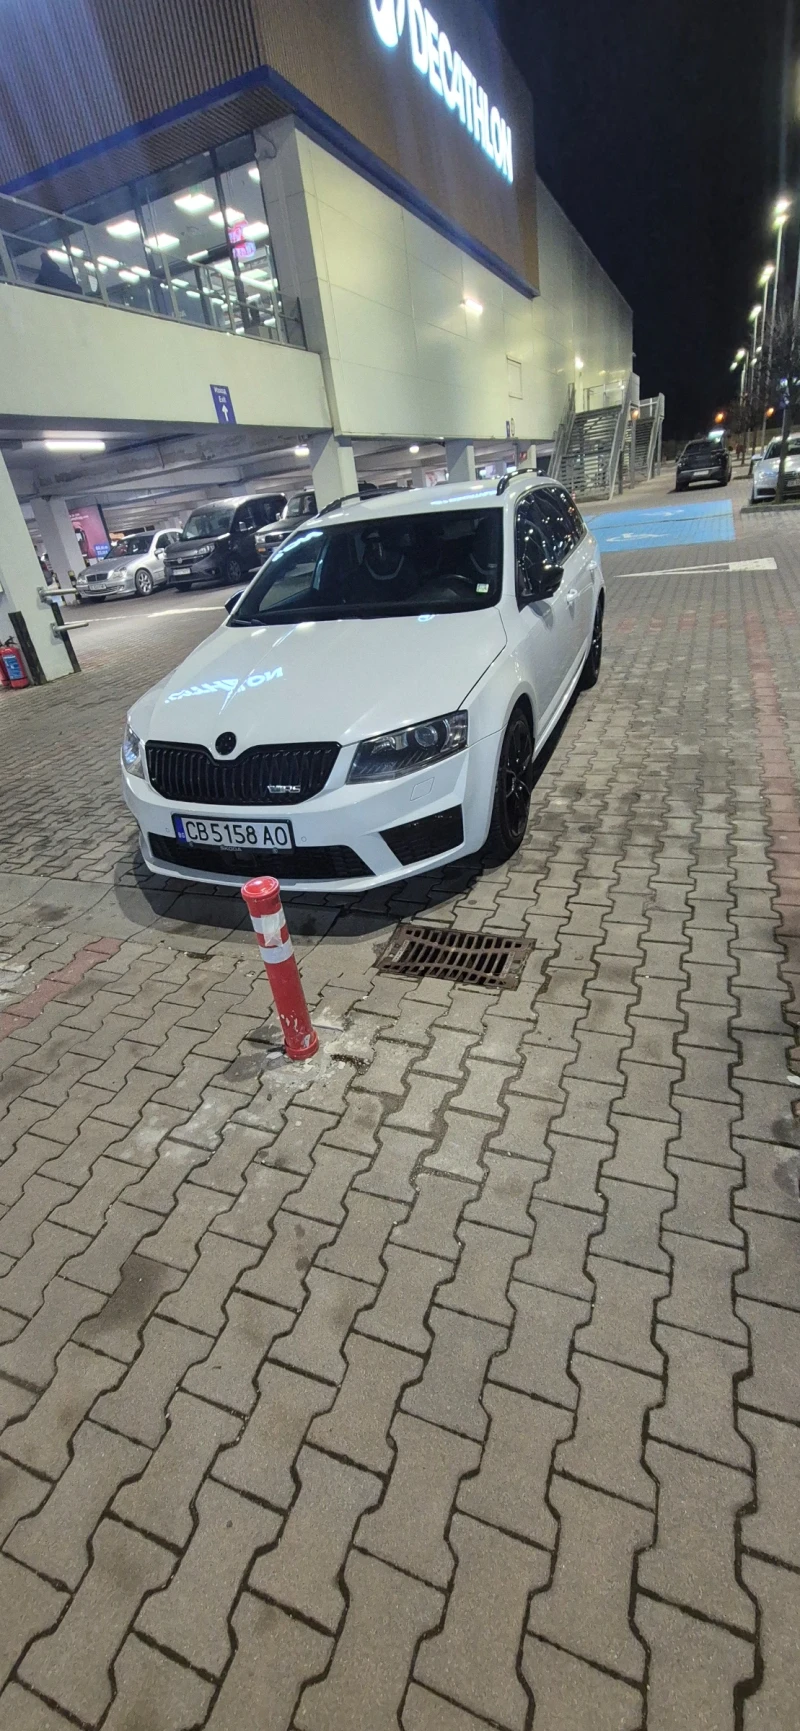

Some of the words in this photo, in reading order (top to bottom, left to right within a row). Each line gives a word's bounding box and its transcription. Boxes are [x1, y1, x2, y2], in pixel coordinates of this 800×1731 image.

[407, 0, 513, 183] DECATHLON
[185, 821, 209, 842] CB
[211, 823, 258, 844] 5158
[263, 825, 288, 846] AO
